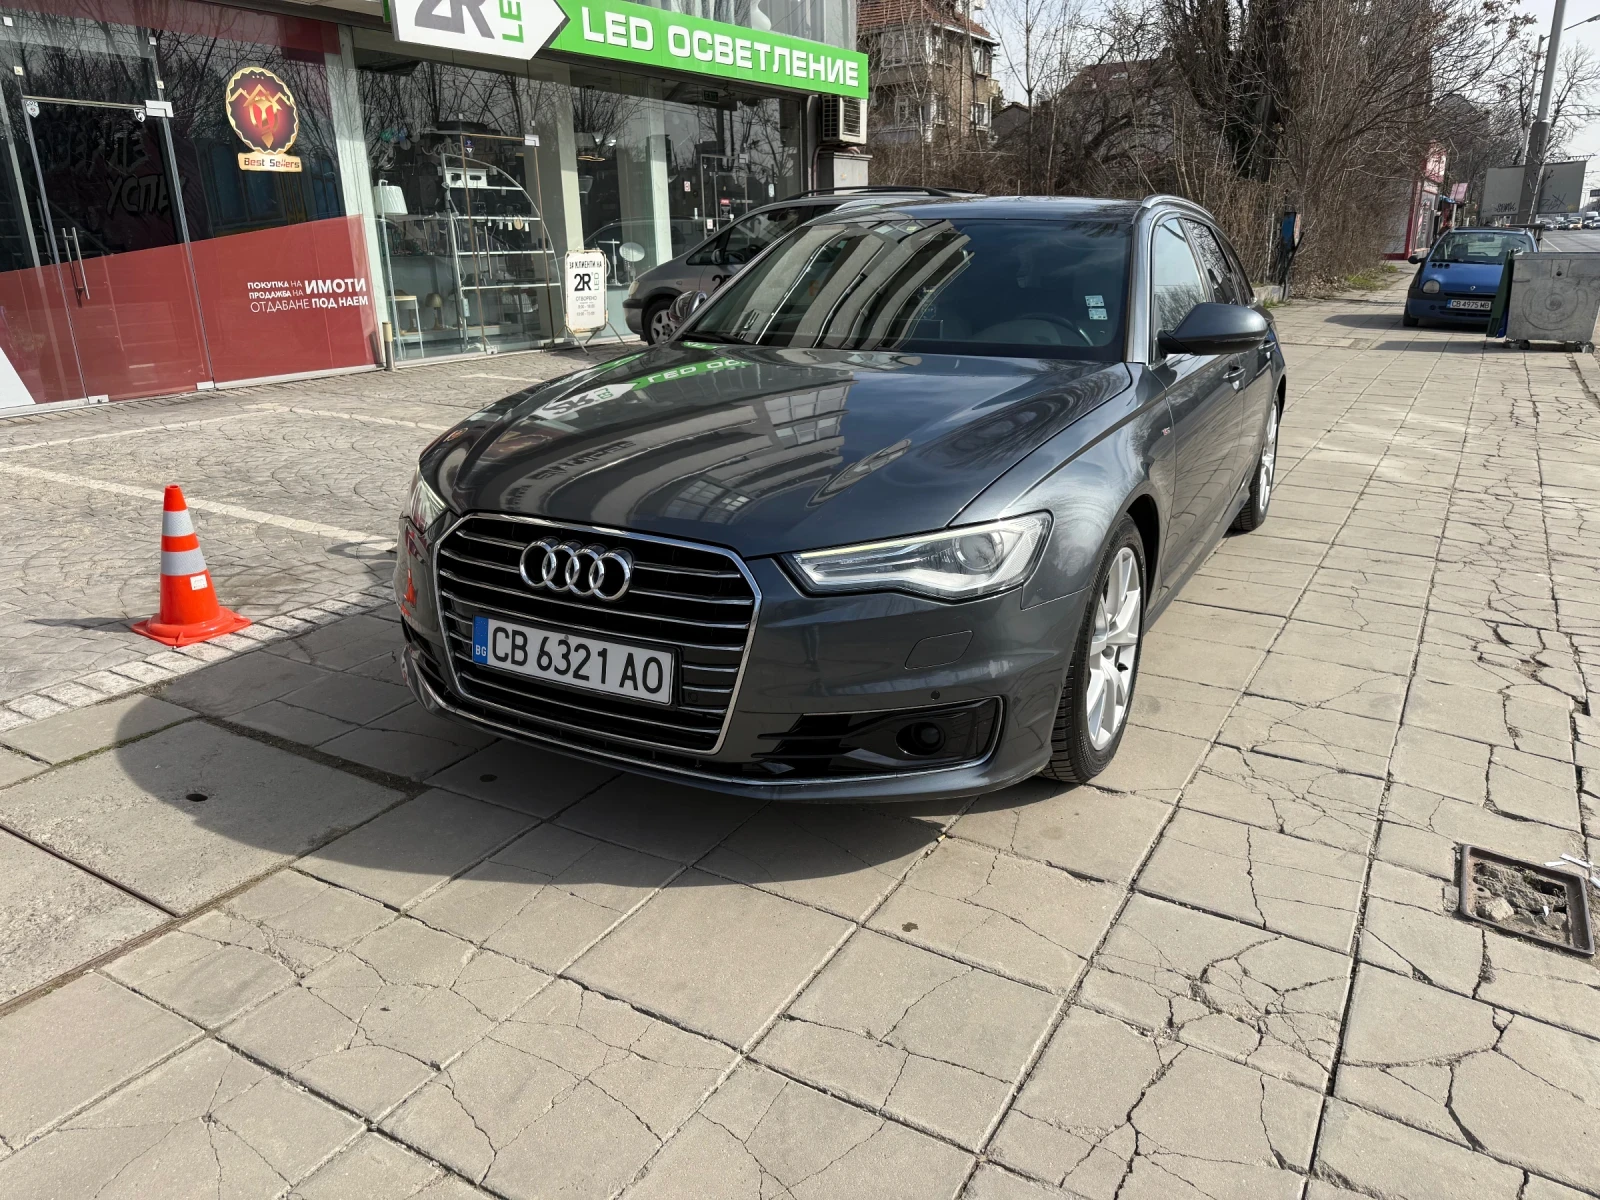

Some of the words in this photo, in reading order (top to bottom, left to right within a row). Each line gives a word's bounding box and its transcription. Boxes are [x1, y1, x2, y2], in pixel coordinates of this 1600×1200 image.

[581, 6, 654, 51] LED
[667, 25, 859, 87] ОСВЕТЛЕНИЕ
[244, 157, 265, 167] Best
[269, 158, 300, 169] Sellers
[575, 261, 595, 269] КЛИЕНТИ
[247, 280, 289, 289] ПОКУПКА
[290, 280, 302, 288] НА
[304, 278, 367, 295] ИМОТИ
[574, 273, 592, 291] 2R
[249, 291, 292, 300] ПРОДАЖБА
[250, 299, 310, 313] ОТДАВАНЕ
[311, 298, 338, 309] ПОД
[339, 295, 369, 307] НАЕМ
[1480, 301, 1490, 309] MB
[475, 644, 487, 657] BG
[492, 626, 529, 666] CB
[536, 636, 608, 685] 6321
[618, 652, 664, 694] AO
